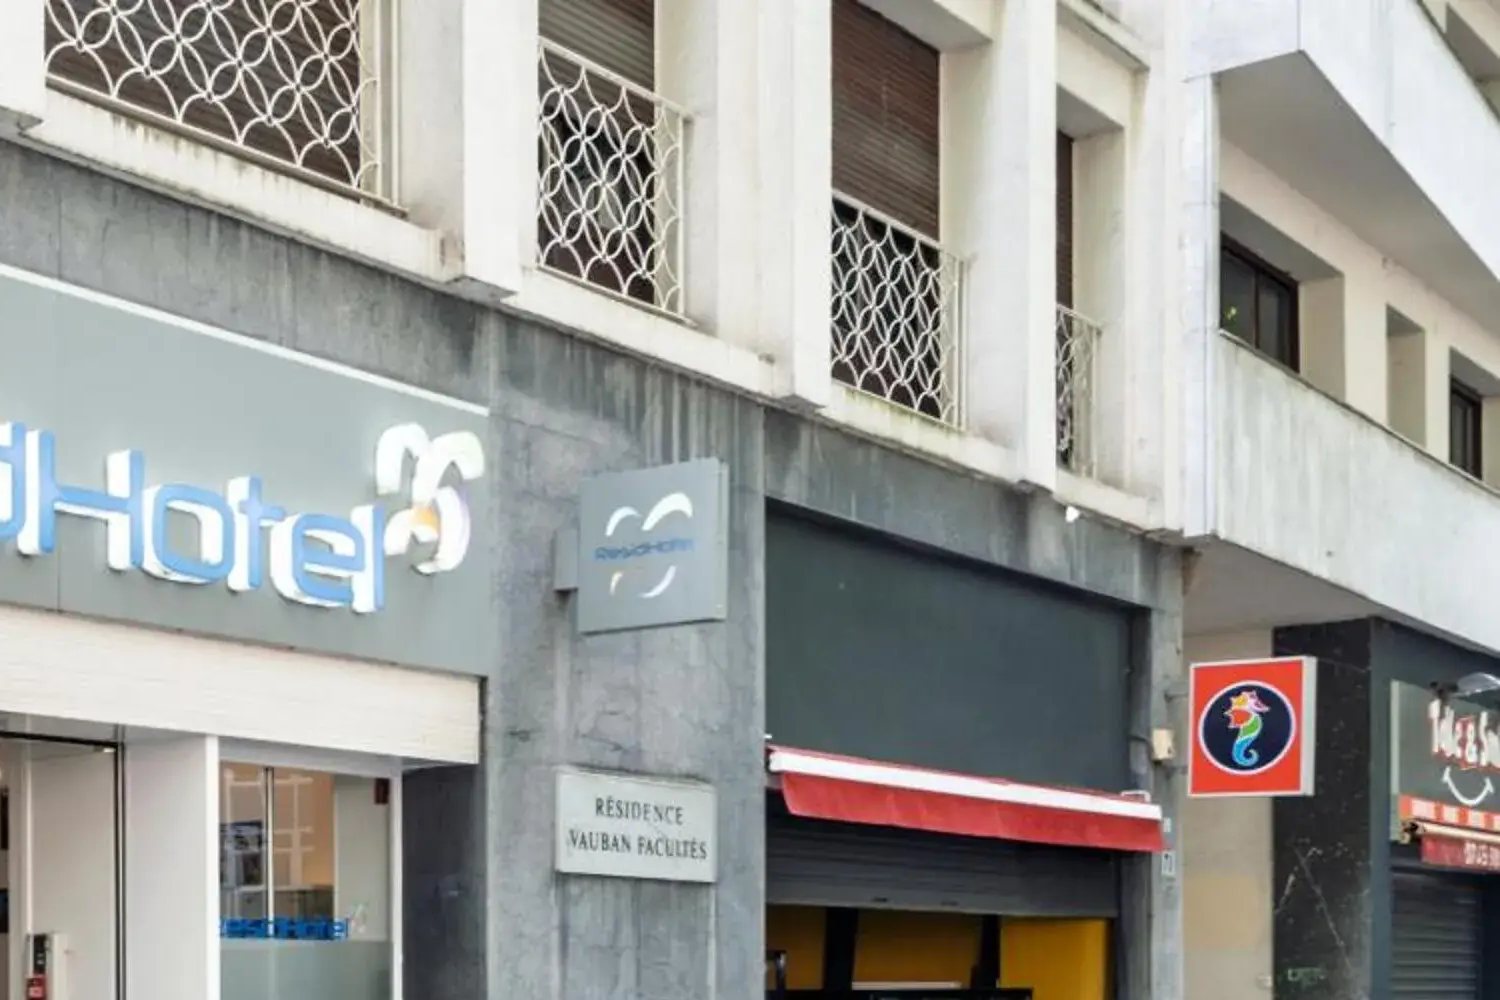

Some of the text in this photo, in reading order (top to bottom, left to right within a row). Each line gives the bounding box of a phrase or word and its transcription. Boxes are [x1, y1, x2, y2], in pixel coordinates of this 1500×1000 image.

[595, 795, 684, 825] RÉSIDENCE
[569, 828, 707, 860] VAUBAN FACULTÉS
